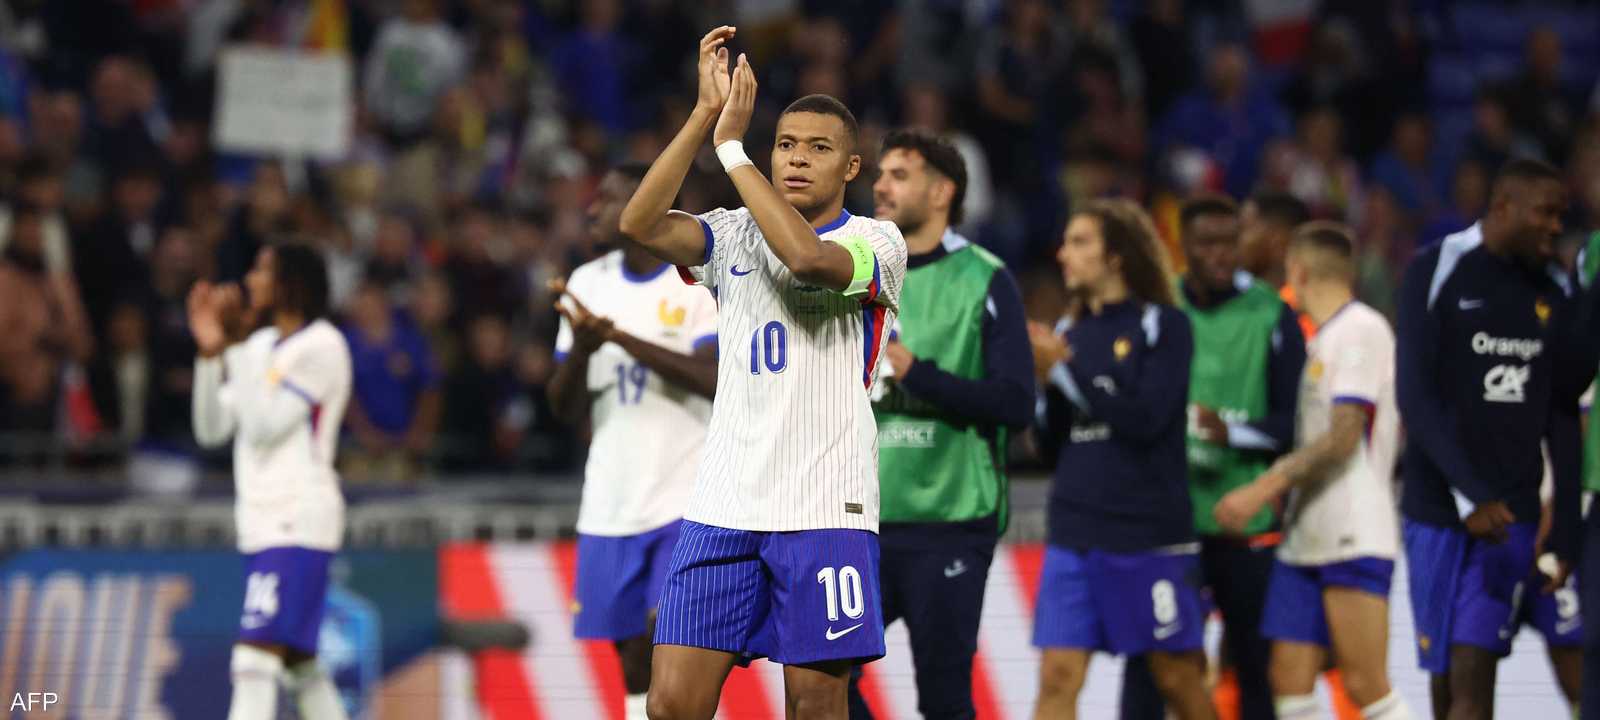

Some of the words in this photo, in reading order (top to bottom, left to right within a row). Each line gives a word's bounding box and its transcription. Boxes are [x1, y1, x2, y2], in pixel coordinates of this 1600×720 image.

[750, 320, 788, 375] 10
[616, 361, 647, 404] 19
[817, 565, 864, 621] 10
[1152, 579, 1177, 623] 8
